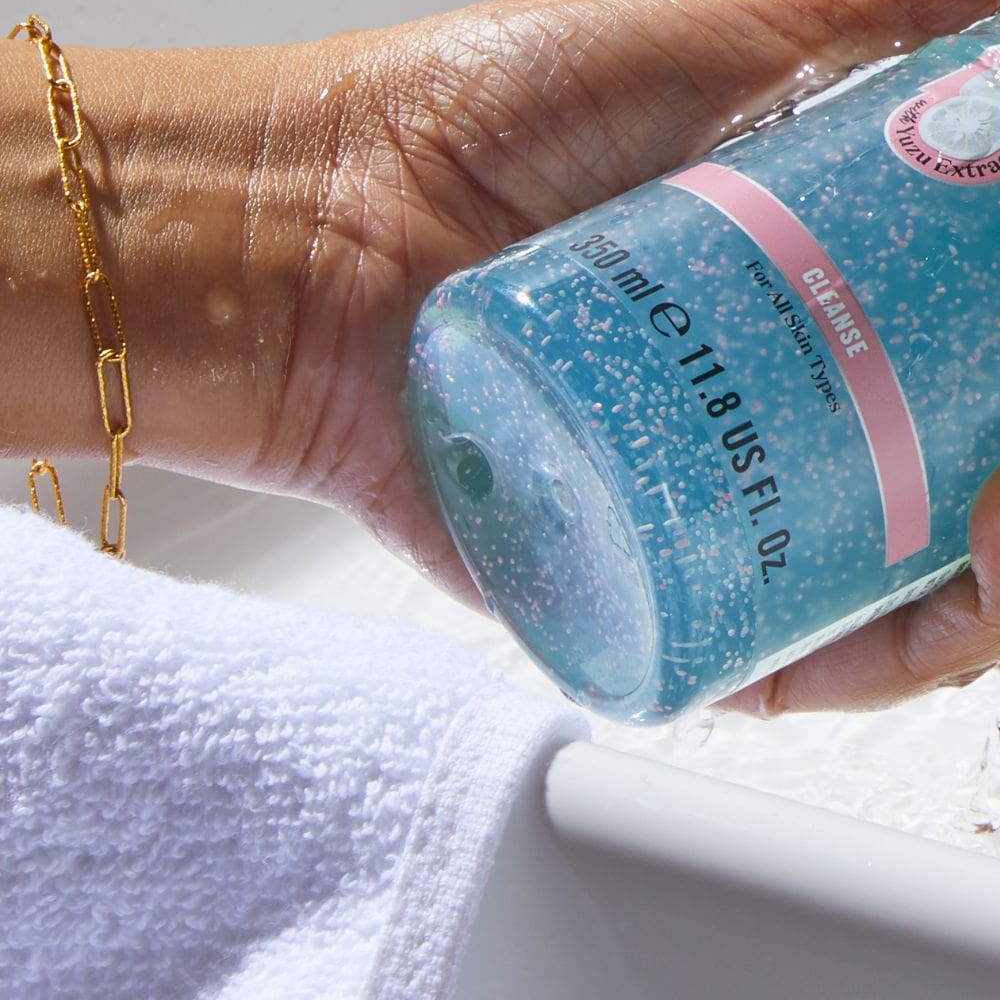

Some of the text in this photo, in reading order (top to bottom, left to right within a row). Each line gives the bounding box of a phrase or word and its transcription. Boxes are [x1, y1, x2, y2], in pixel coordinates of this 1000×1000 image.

[896, 124, 932, 167] Yuzu
[744, 259, 842, 414] For All Skin Types
[800, 267, 869, 359] CLEANSE
[569, 234, 631, 270] 350
[611, 266, 666, 303] ml
[679, 342, 743, 418] 11.8
[722, 419, 766, 474] US
[757, 528, 792, 585] Oz.
